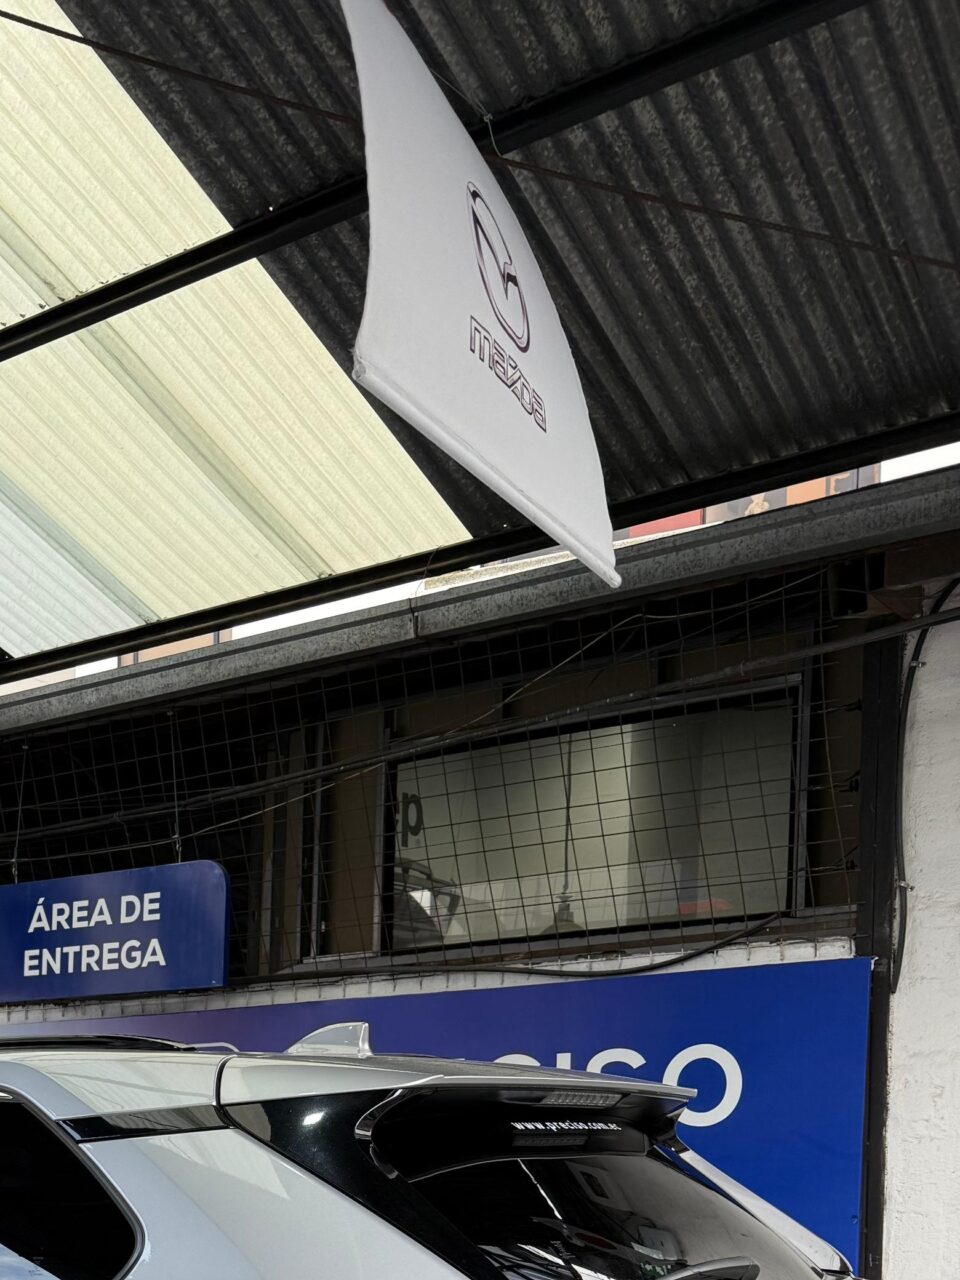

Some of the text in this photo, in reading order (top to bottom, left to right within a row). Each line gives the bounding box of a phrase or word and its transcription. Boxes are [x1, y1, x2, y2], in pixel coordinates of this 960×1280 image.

[27, 891, 161, 933] ÁREA DE
[23, 938, 167, 977] ENTREGA
